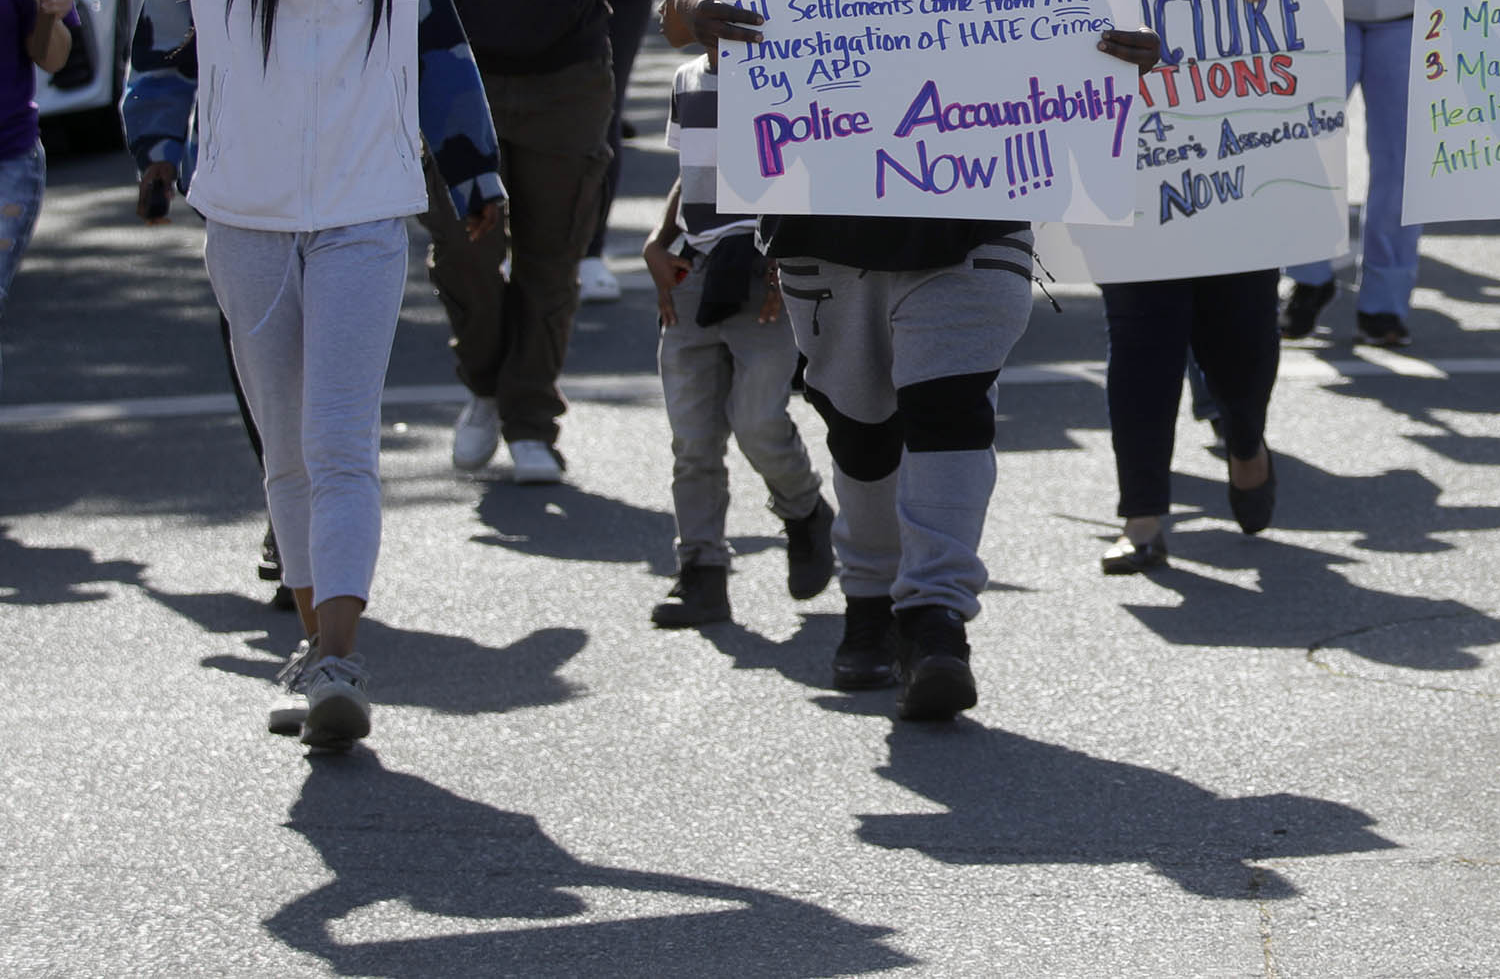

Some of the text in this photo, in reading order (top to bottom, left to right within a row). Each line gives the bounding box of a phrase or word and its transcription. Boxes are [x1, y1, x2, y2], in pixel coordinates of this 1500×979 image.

[738, 15, 1116, 69] Investigation of HATE Crimes
[748, 59, 872, 106] By APD
